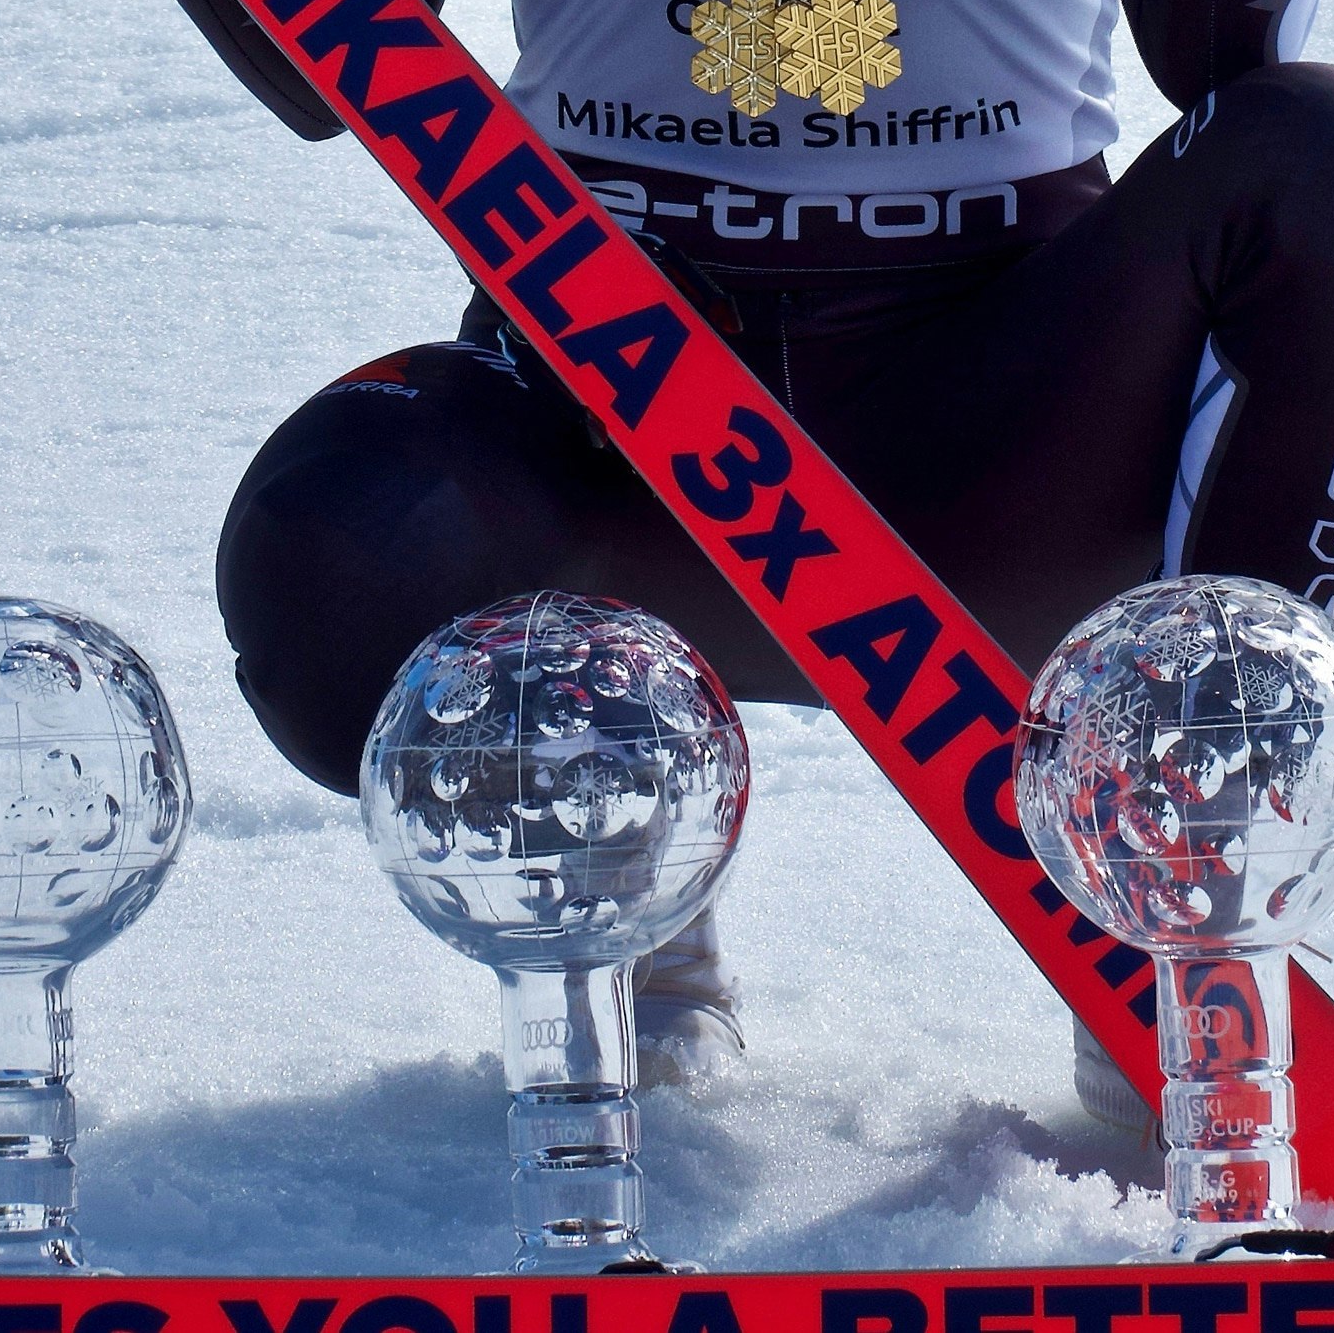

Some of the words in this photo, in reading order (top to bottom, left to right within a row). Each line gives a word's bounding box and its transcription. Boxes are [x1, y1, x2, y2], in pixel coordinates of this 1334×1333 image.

[734, 28, 773, 66] FIS
[819, 27, 859, 66] FIS
[557, 91, 781, 149] Mikaela
[803, 97, 1022, 148] Shiffrin
[580, 180, 1019, 241] e-tron
[671, 406, 840, 604] 3x
[807, 594, 1159, 1029] ATO
[1192, 1099, 1222, 1117] SKI
[1211, 1117, 1254, 1136] CUP
